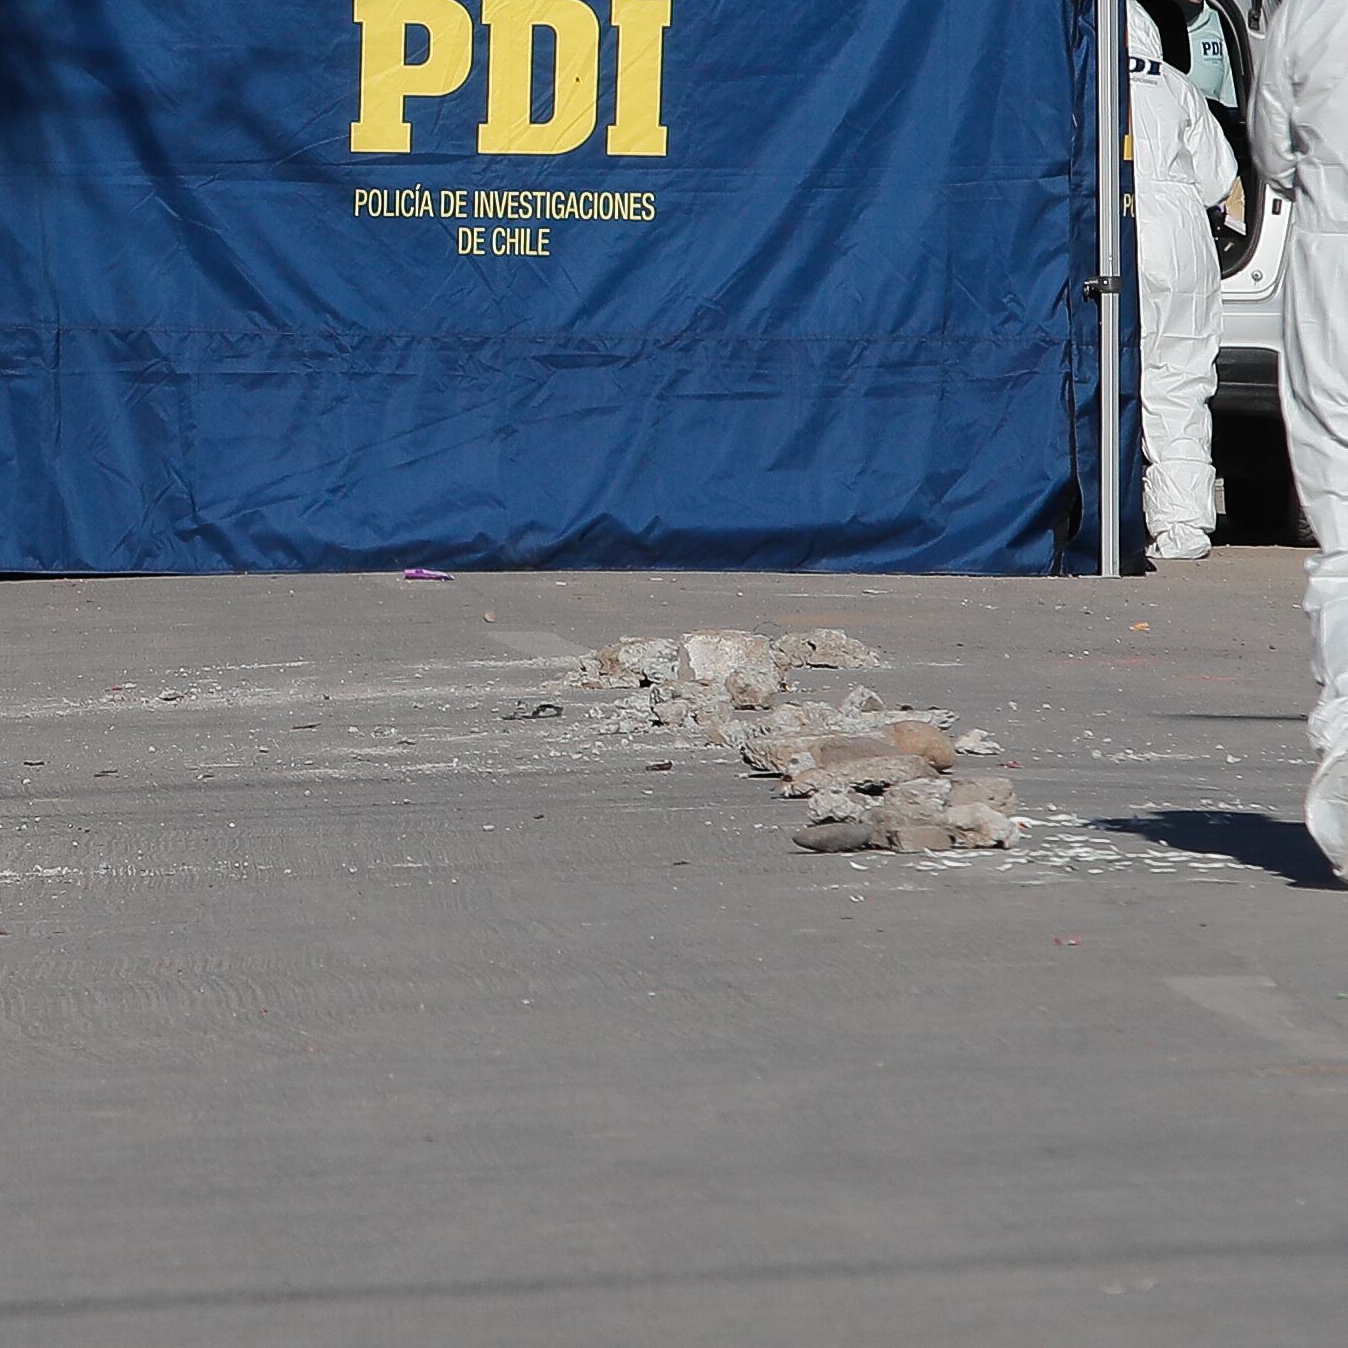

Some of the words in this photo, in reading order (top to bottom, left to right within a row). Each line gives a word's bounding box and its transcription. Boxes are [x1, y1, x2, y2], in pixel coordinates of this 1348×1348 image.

[1202, 41, 1223, 56] PDI
[354, 183, 434, 218] POLICÍA
[440, 190, 468, 219] DE
[474, 190, 656, 221] INVESTIGACIONES
[458, 227, 486, 256] DE
[492, 227, 551, 257] CHILE
